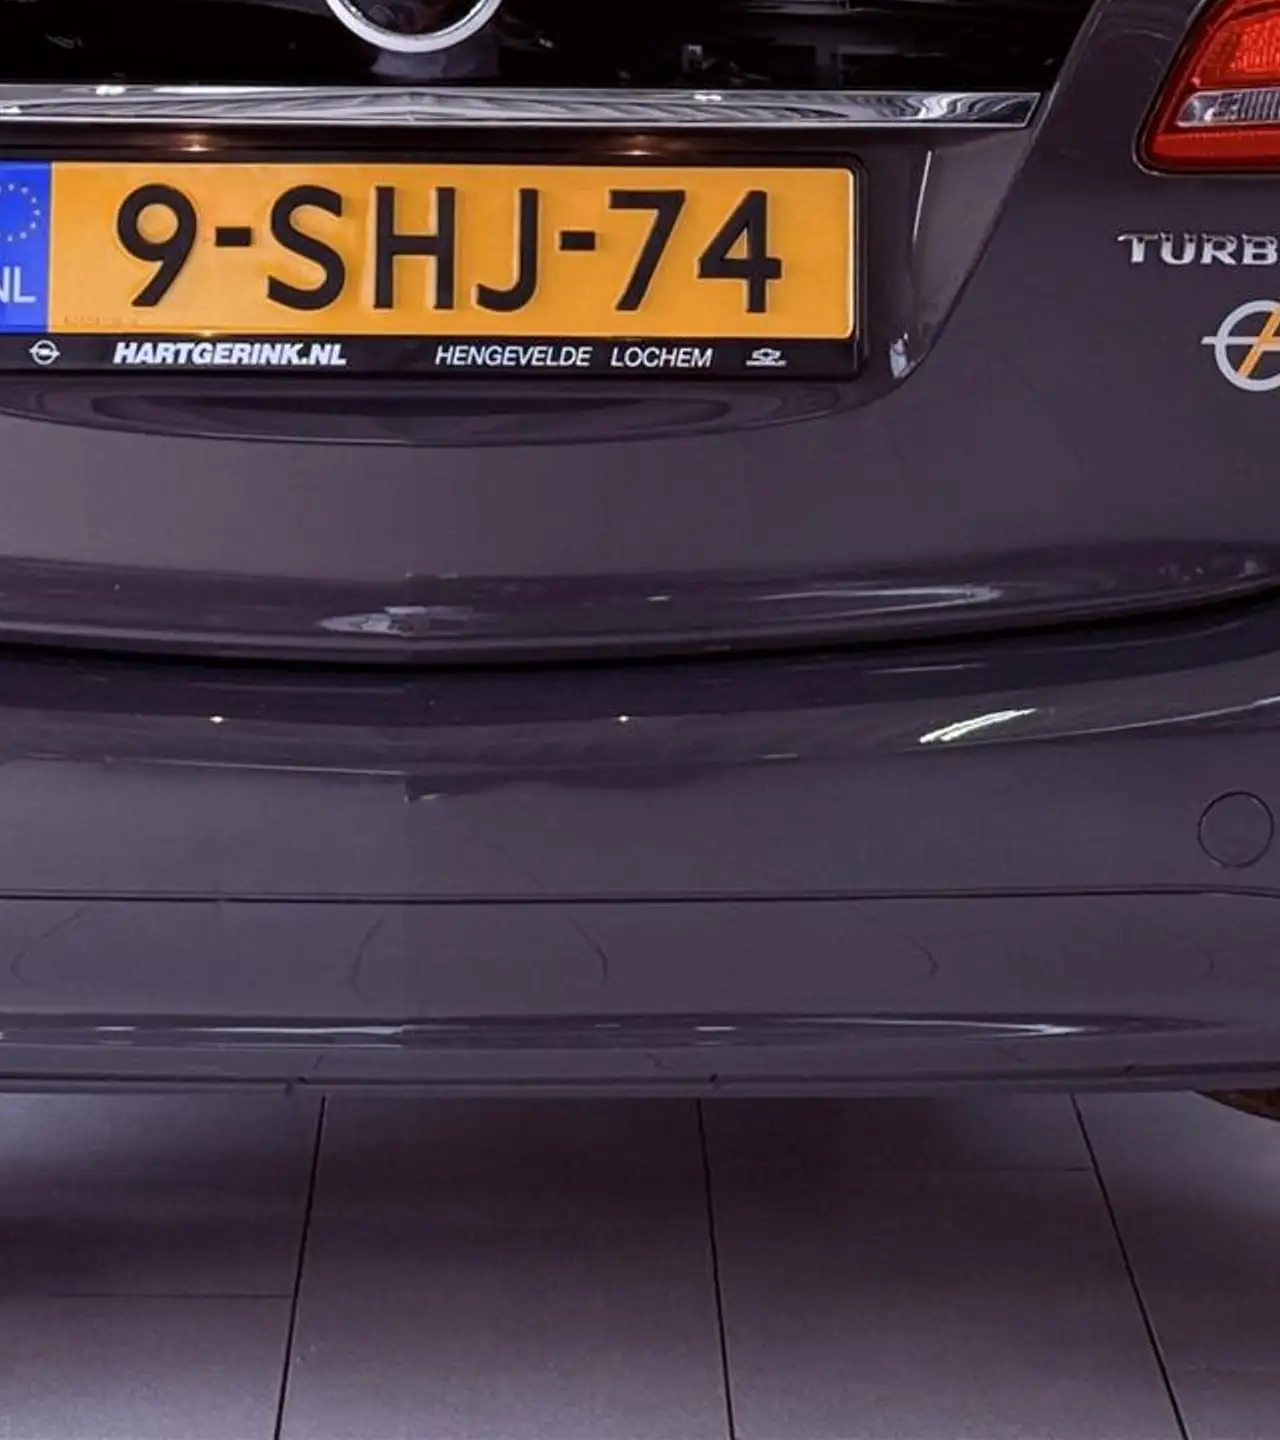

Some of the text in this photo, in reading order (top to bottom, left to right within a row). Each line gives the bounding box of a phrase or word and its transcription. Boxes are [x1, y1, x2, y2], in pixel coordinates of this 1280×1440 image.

[117, 184, 784, 314] 9-SHJ-74
[113, 342, 347, 366] HARTGERINK.NL
[435, 346, 713, 368] HENGEVELDE LOCHEM
